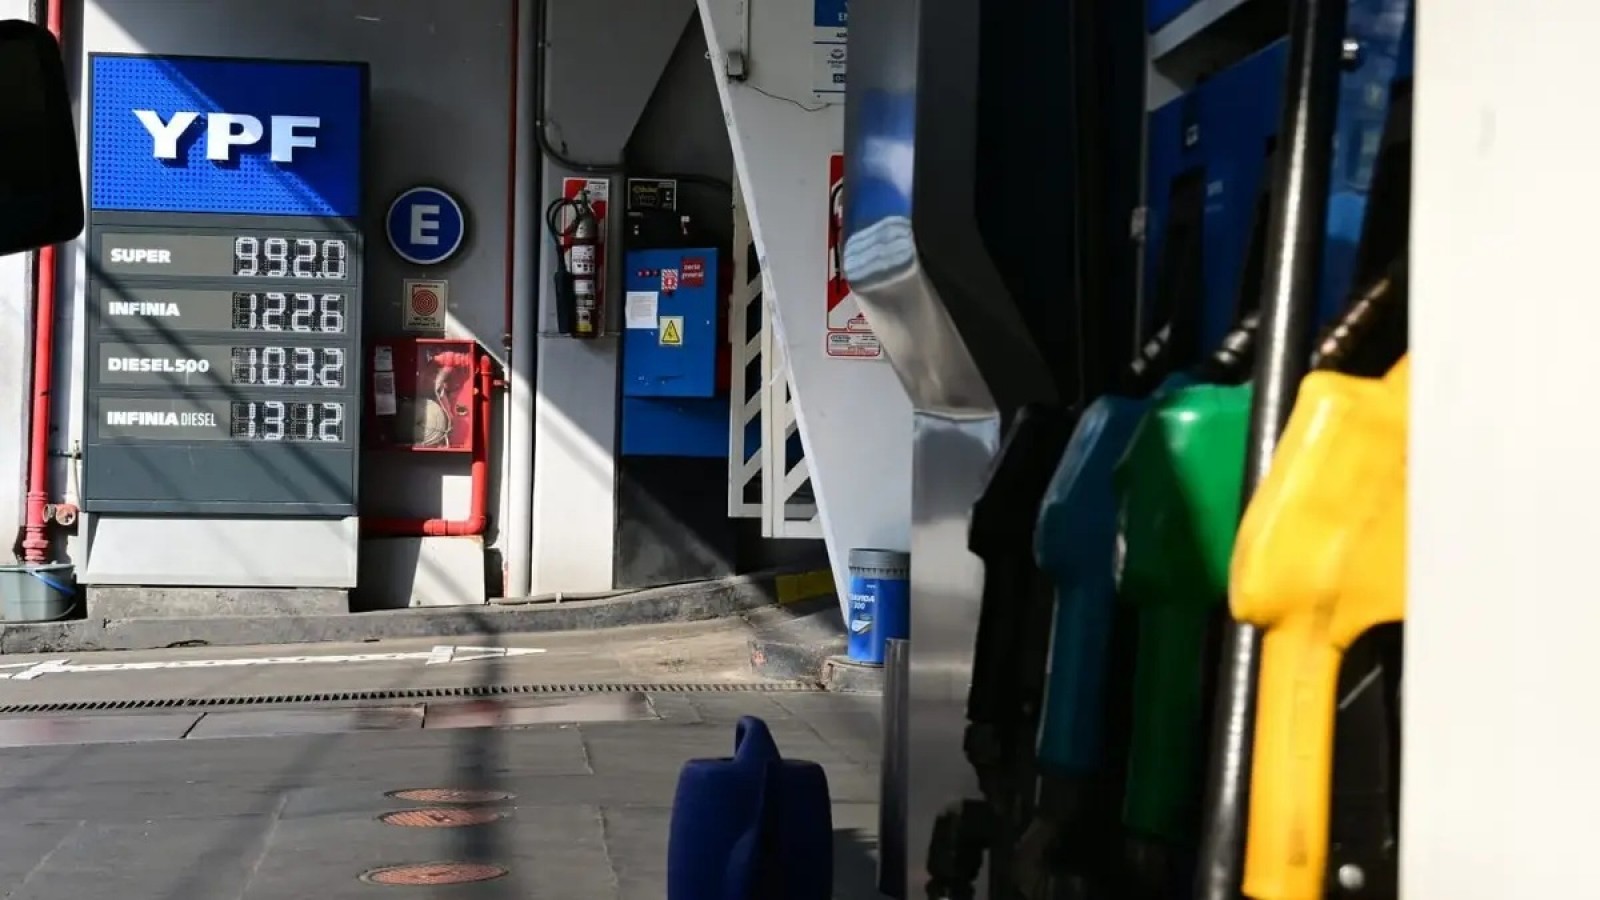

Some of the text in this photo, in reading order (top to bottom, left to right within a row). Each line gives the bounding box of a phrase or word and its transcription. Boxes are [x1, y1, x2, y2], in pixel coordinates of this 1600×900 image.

[132, 109, 321, 163] YPF
[410, 204, 440, 245] E
[110, 248, 171, 264] SUPER
[108, 292, 343, 332] INFINIA 1226
[107, 400, 342, 441] INFINIA DIESEL 1312
